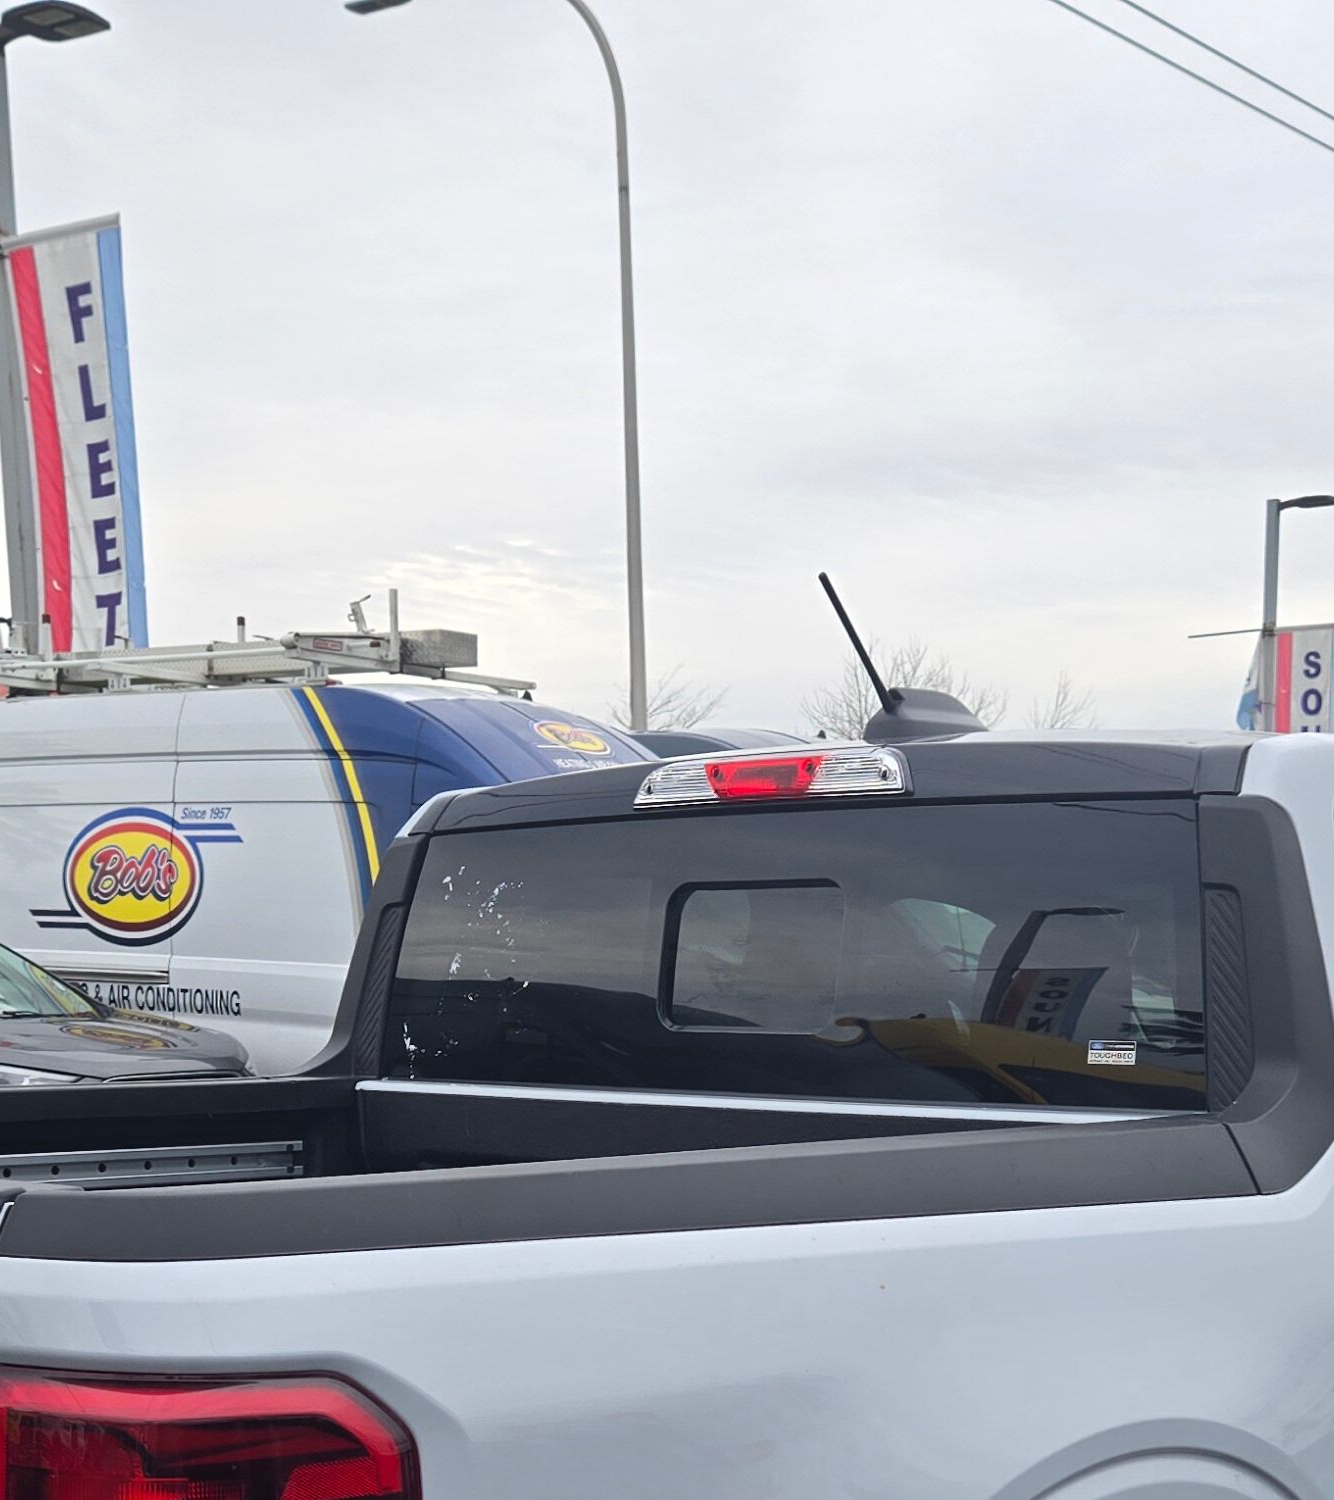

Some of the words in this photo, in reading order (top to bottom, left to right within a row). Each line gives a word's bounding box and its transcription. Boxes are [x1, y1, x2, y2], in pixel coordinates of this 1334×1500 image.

[64, 281, 123, 647] FLEET
[180, 807, 207, 820] Since
[209, 807, 233, 820] 1957
[88, 844, 179, 904] Bob's
[108, 984, 133, 1010] AIR
[135, 985, 242, 1017] CONDITIONING
